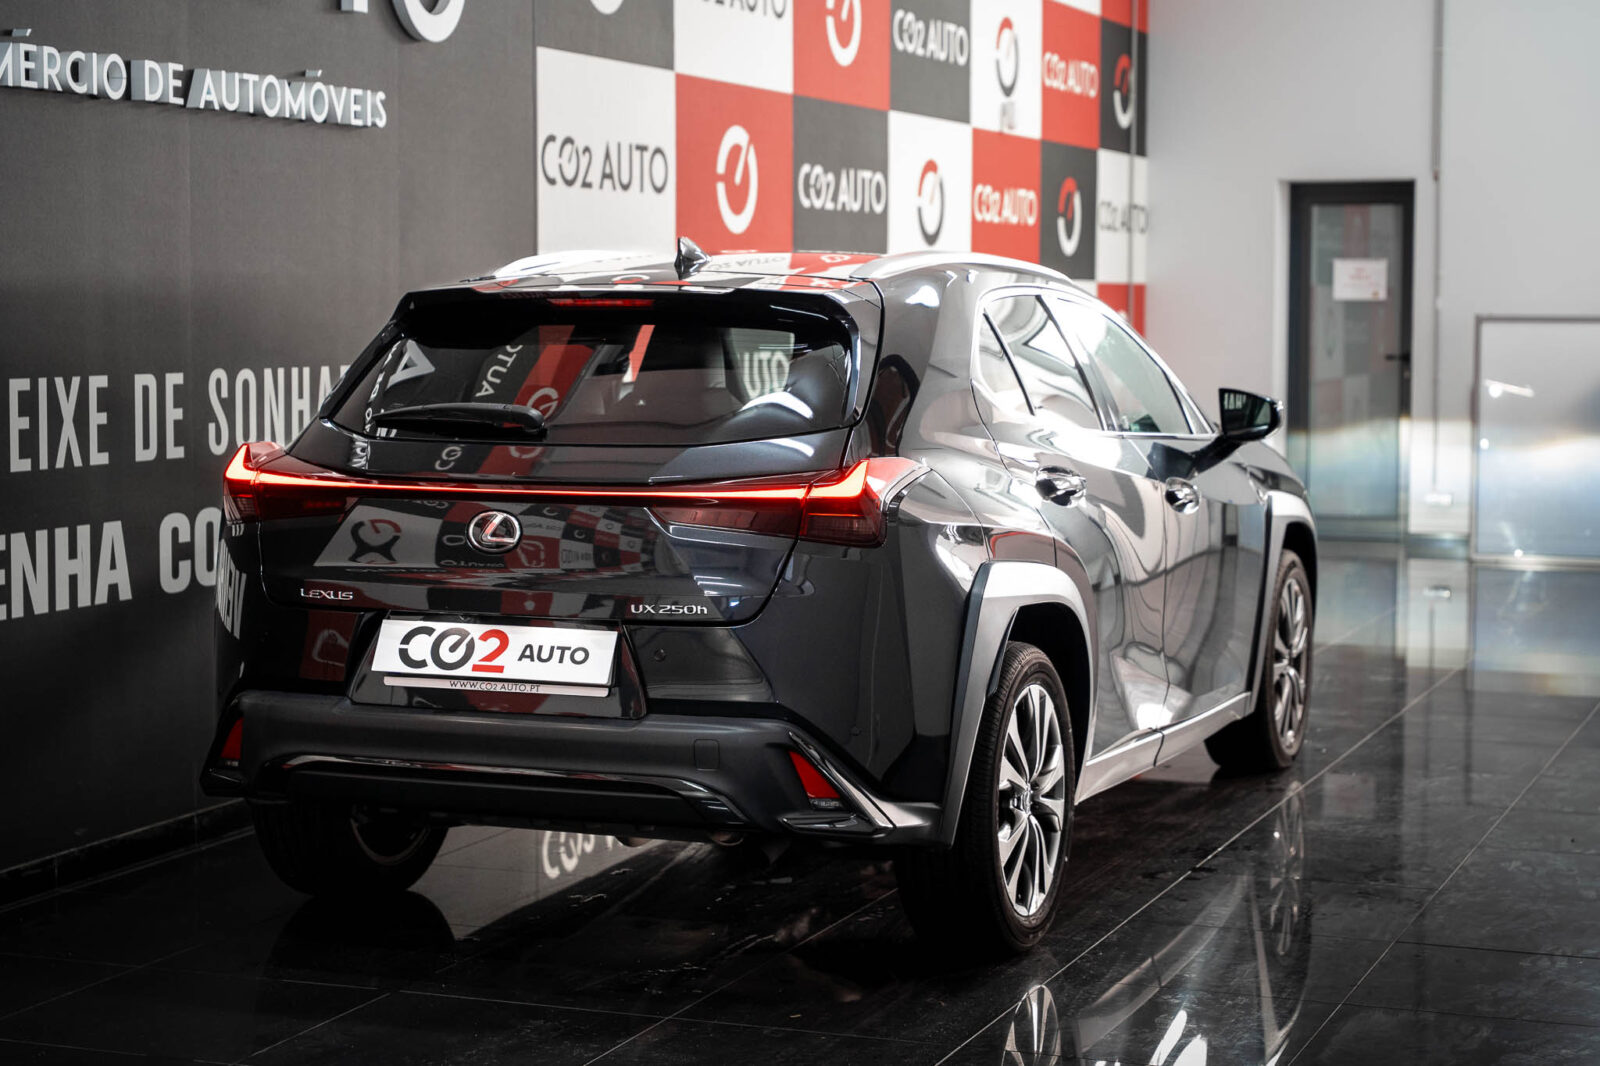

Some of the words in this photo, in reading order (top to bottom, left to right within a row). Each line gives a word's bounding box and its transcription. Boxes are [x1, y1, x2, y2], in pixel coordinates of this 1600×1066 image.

[893, 9, 926, 57] CO2
[926, 19, 969, 66] AUTO
[140, 59, 184, 105] DE
[194, 68, 387, 128] AUTOMÓVEIS
[1067, 59, 1099, 98] AUTO
[541, 133, 593, 189] CO2
[599, 140, 669, 194] AUTO
[798, 162, 836, 211] CO2
[836, 167, 887, 215] AUTO
[1001, 187, 1038, 226] AUTO
[9, 375, 109, 473] EIXE
[134, 372, 185, 462] DE
[300, 588, 353, 600] LEXUS
[630, 604, 656, 614] UX
[658, 604, 708, 615] 250h
[398, 625, 510, 674] CO2
[518, 643, 590, 665] AUTO
